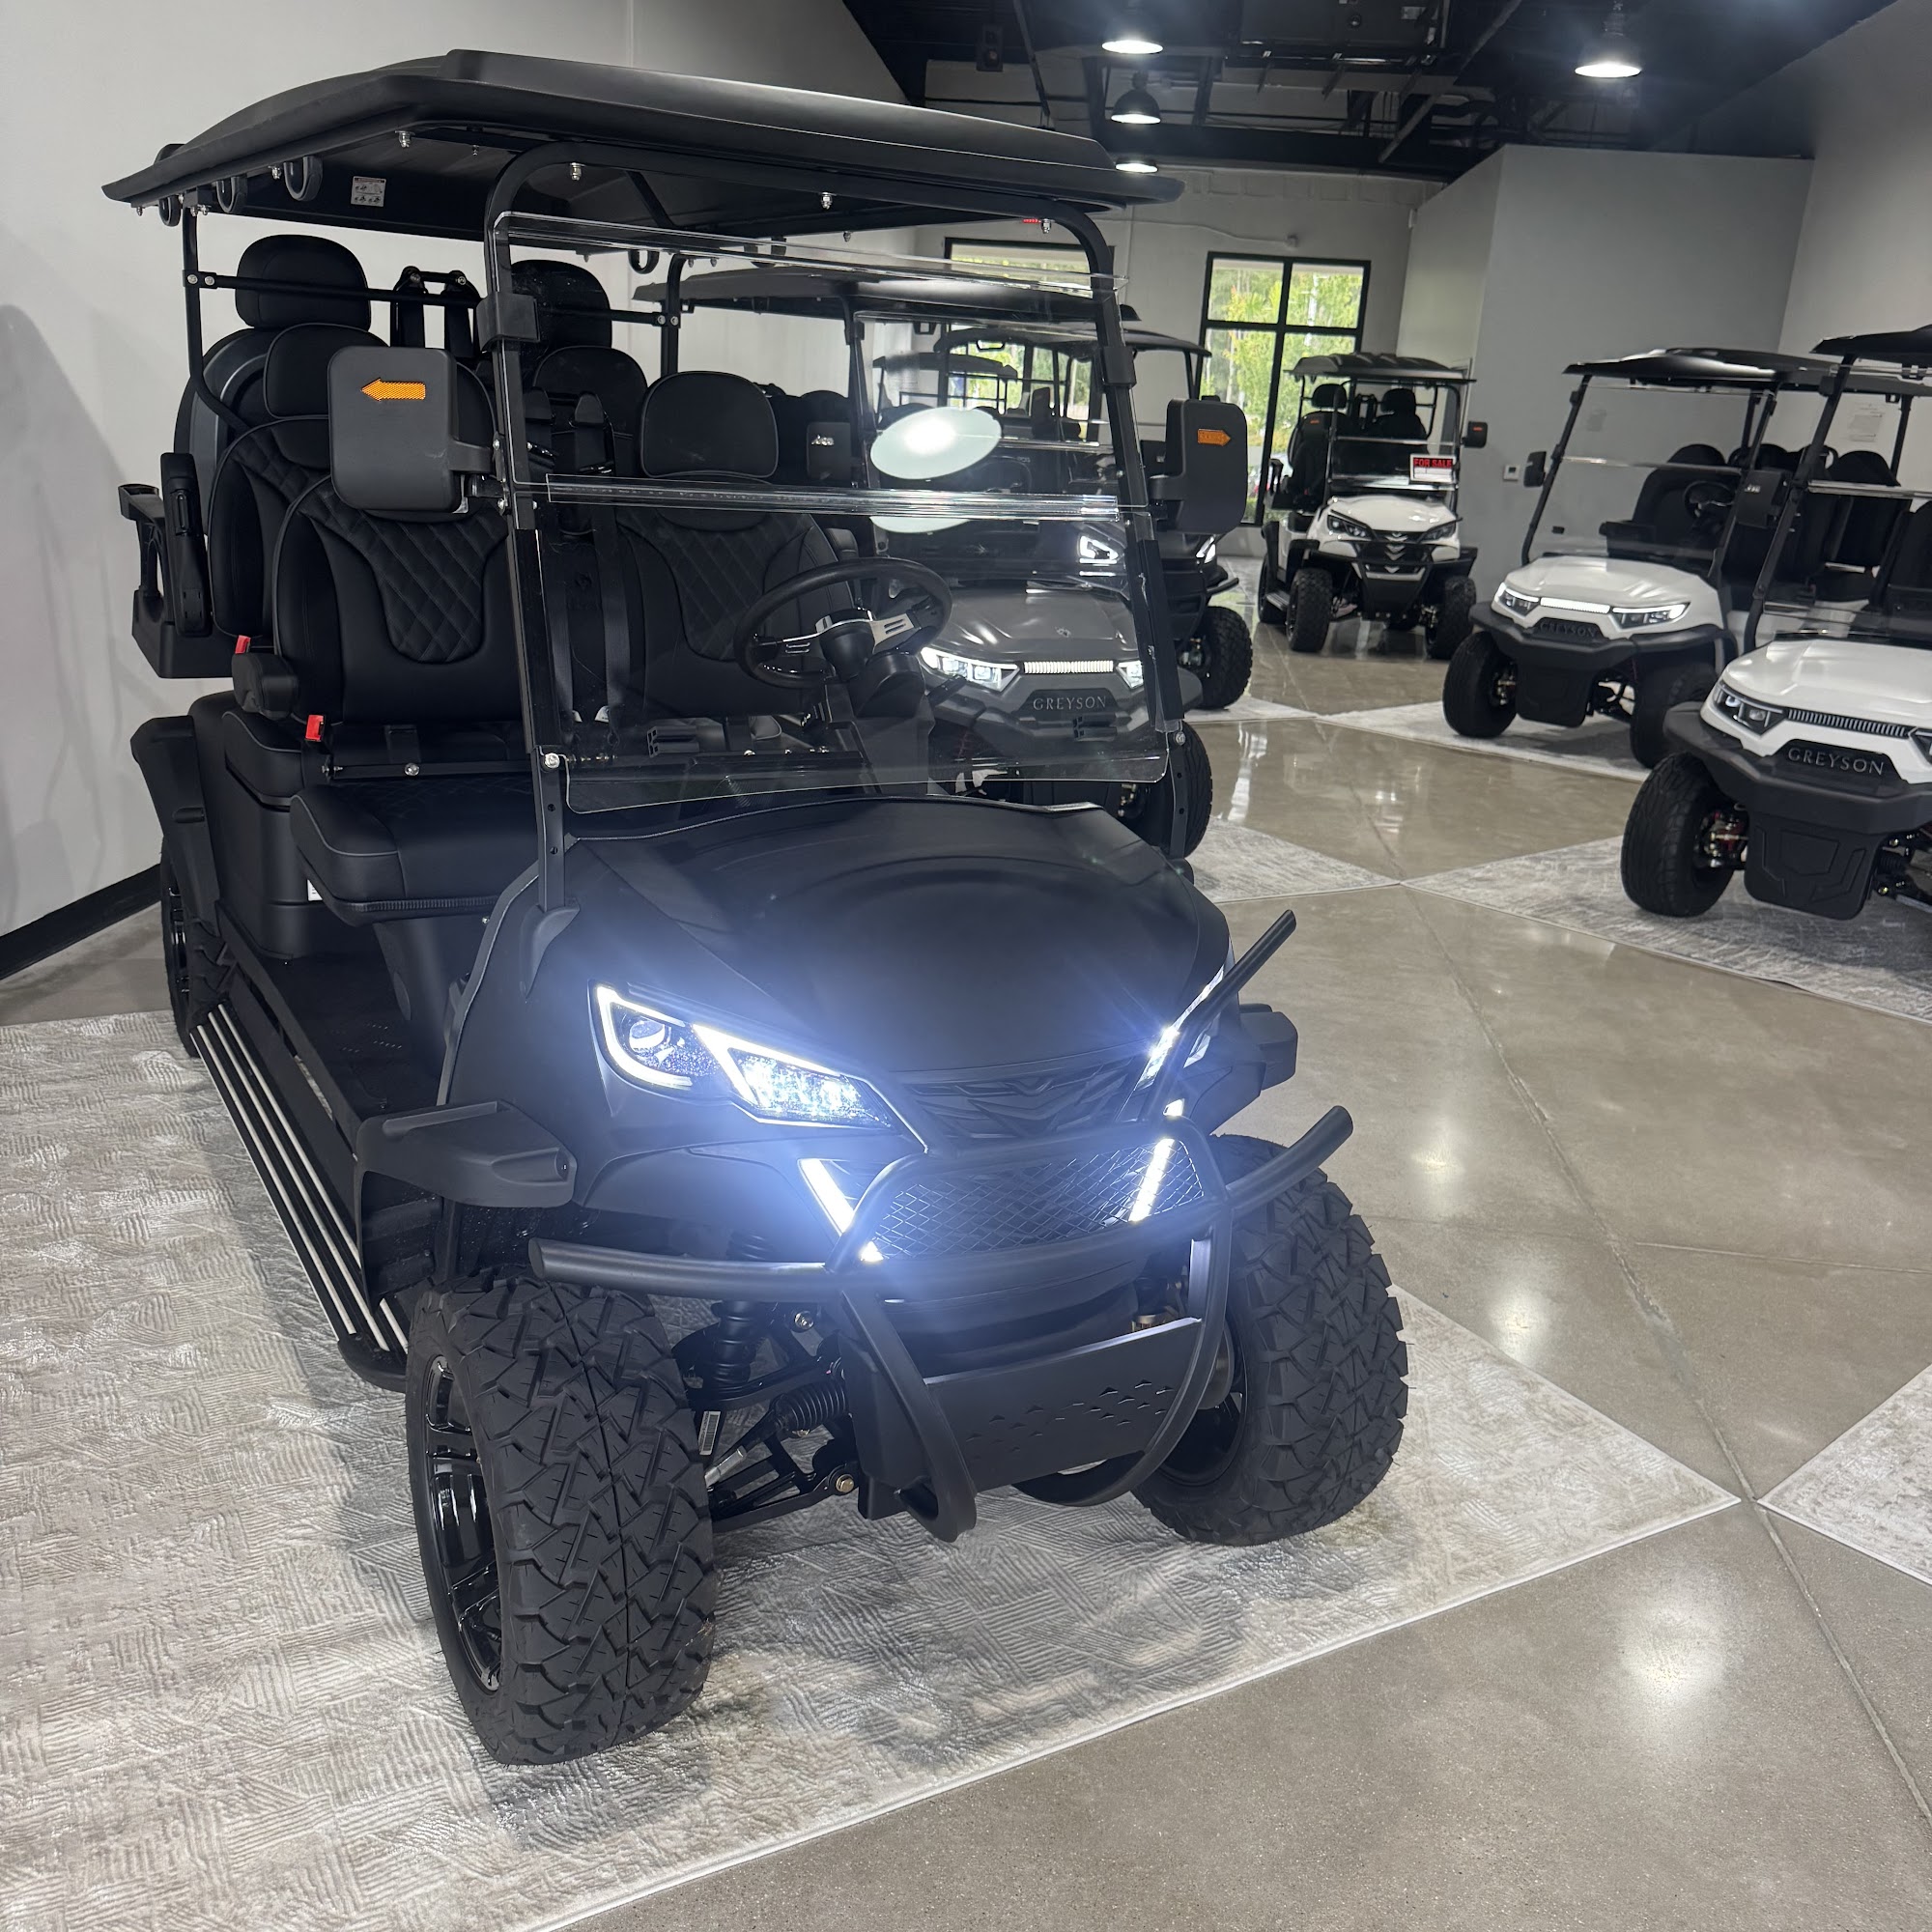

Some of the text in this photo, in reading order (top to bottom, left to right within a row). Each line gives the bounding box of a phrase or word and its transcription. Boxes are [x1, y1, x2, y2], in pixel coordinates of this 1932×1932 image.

[1413, 458, 1452, 469] FOR SALE
[1033, 696, 1106, 710] GREYSON
[1788, 747, 1884, 775] GREYSON
